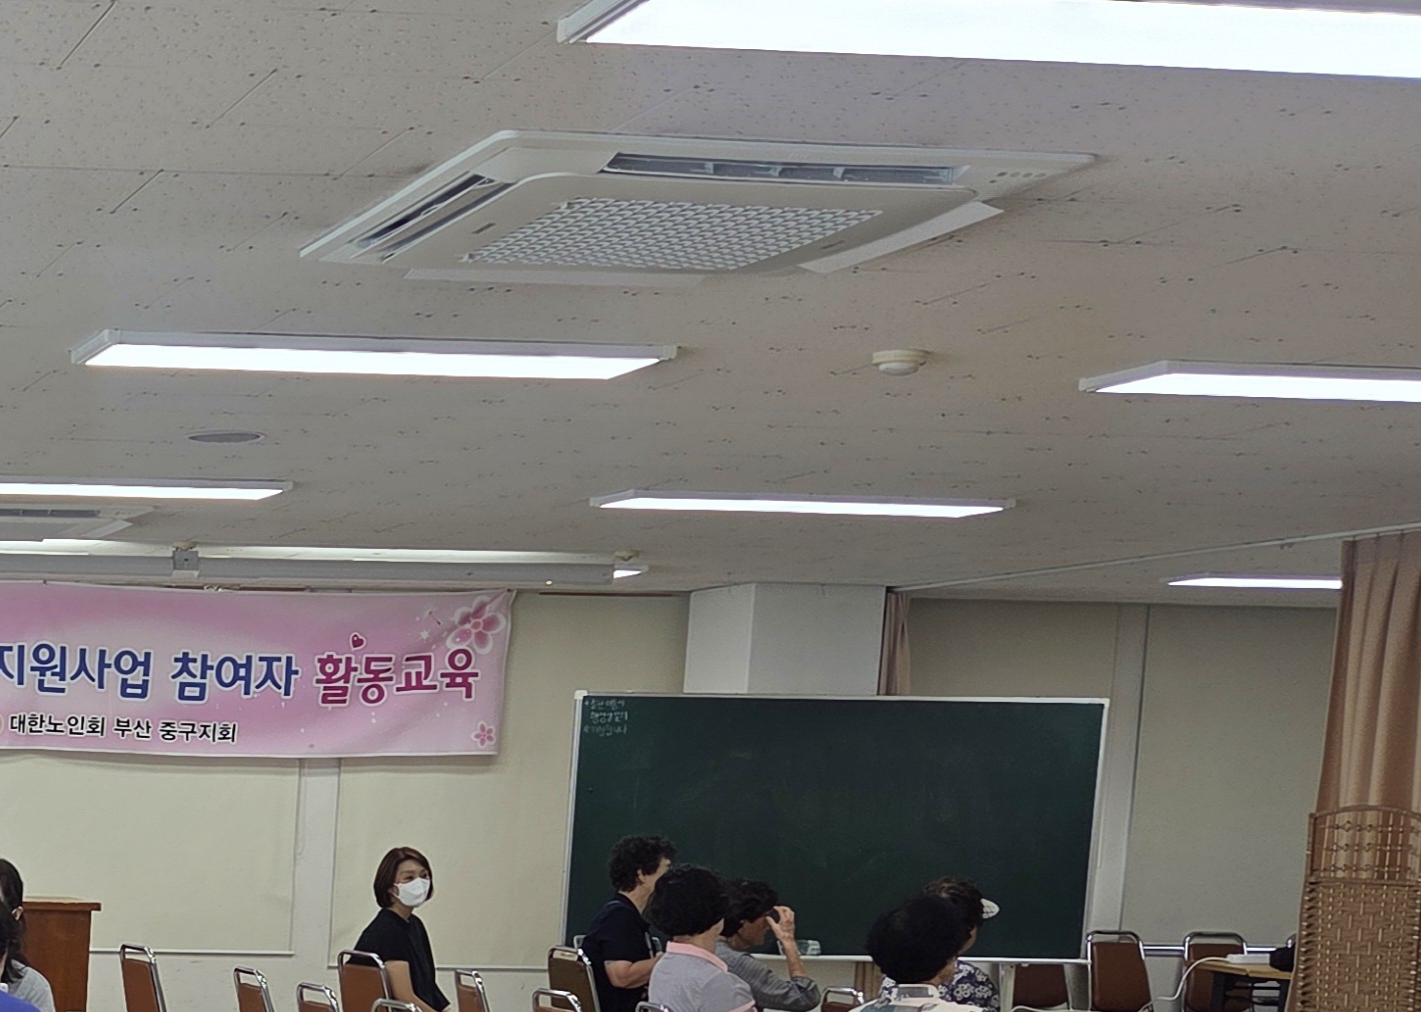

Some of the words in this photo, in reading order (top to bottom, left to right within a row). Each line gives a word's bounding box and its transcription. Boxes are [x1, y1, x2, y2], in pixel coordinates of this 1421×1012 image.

[170, 651, 300, 702] 참여자
[315, 648, 479, 705] 활동교육
[9, 713, 106, 737] 대한노인회
[113, 717, 152, 739] 부산
[158, 720, 237, 743] 중구지회
